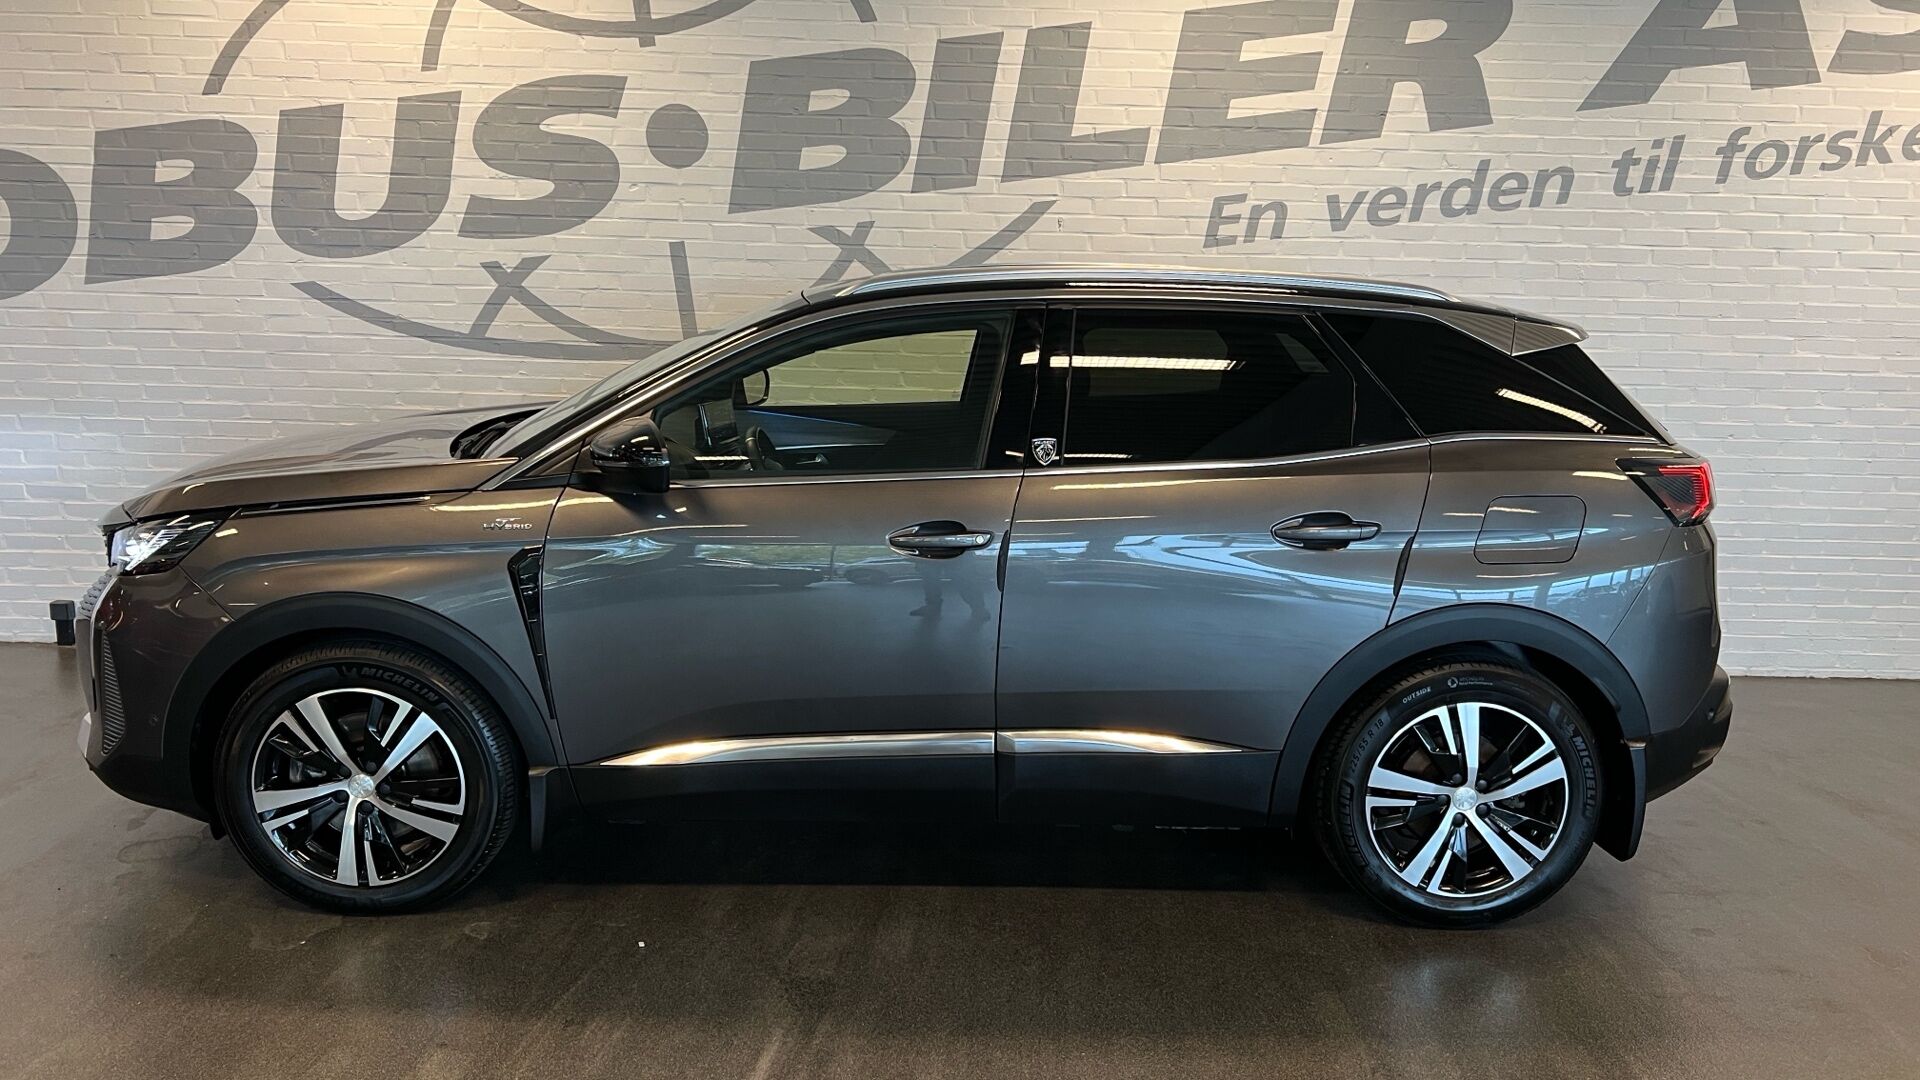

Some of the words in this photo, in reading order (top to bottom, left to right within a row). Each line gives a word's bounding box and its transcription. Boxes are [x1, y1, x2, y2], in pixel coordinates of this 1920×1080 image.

[1202, 193, 1289, 249] En
[1326, 159, 1575, 232] verden
[1612, 134, 1686, 197] til
[483, 517, 532, 530] HYBRID
[360, 667, 439, 702] MICHELIN
[1402, 686, 1432, 704] OUTSIDE
[1573, 735, 1597, 818] MICHELIN
